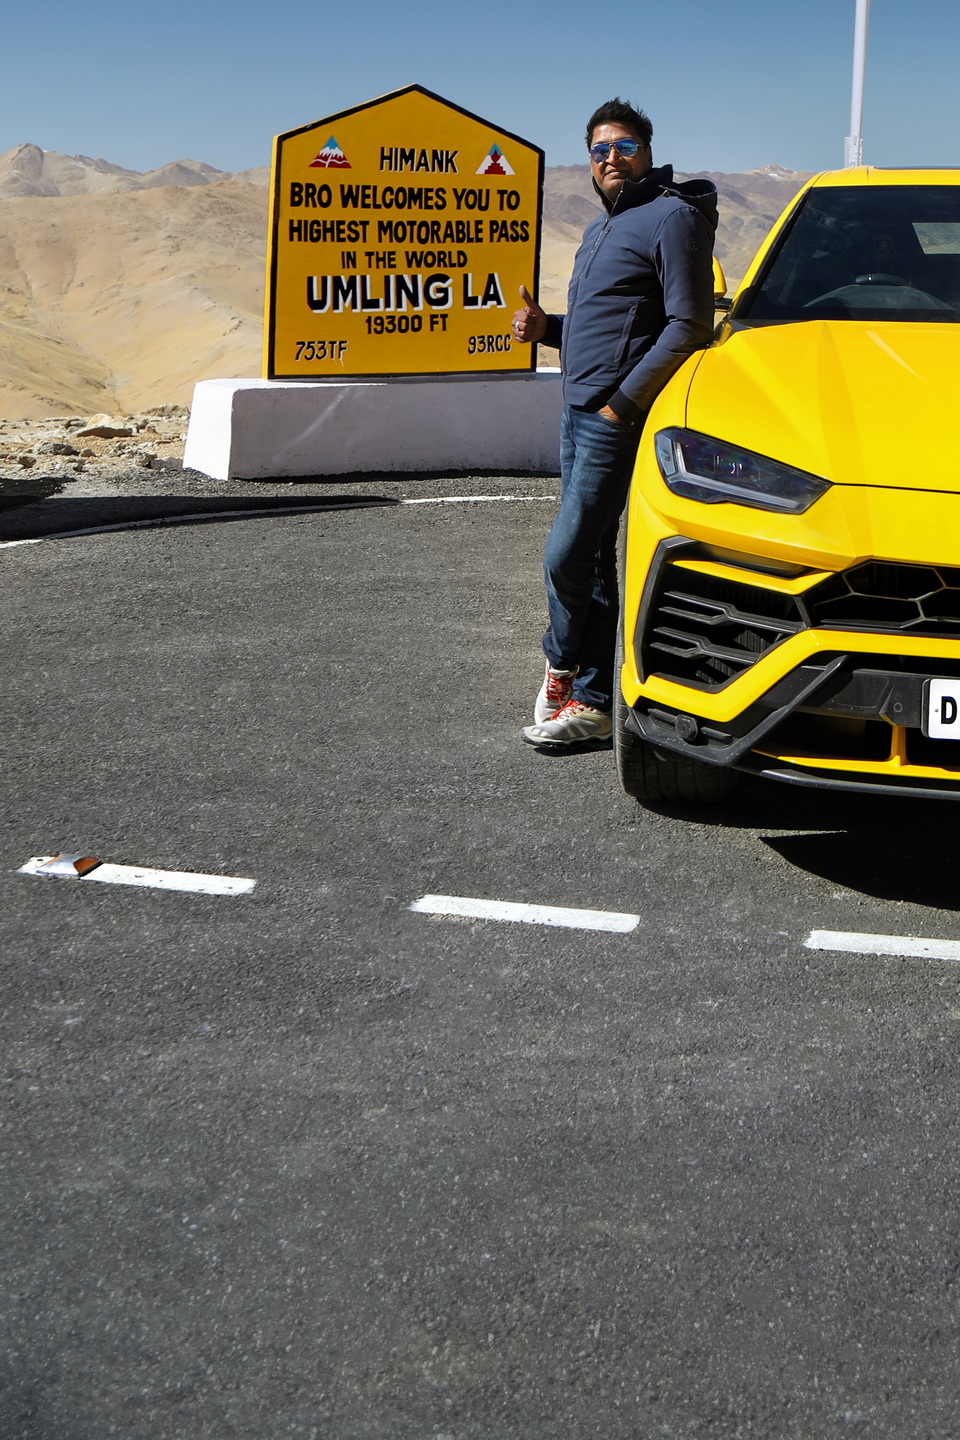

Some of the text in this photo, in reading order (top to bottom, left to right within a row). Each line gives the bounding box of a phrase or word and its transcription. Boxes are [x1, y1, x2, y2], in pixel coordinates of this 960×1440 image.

[379, 147, 459, 174] HIMANK
[290, 182, 520, 211] BRO WELCOMES YOU TO
[289, 219, 530, 244] HIGHEST MOTORABLE PASS
[341, 250, 468, 269] IN THE WORLD
[306, 273, 507, 313] UMLING LA
[365, 314, 448, 334] 19300 FT
[295, 340, 348, 361] 753TF
[468, 334, 511, 355] 93RCC
